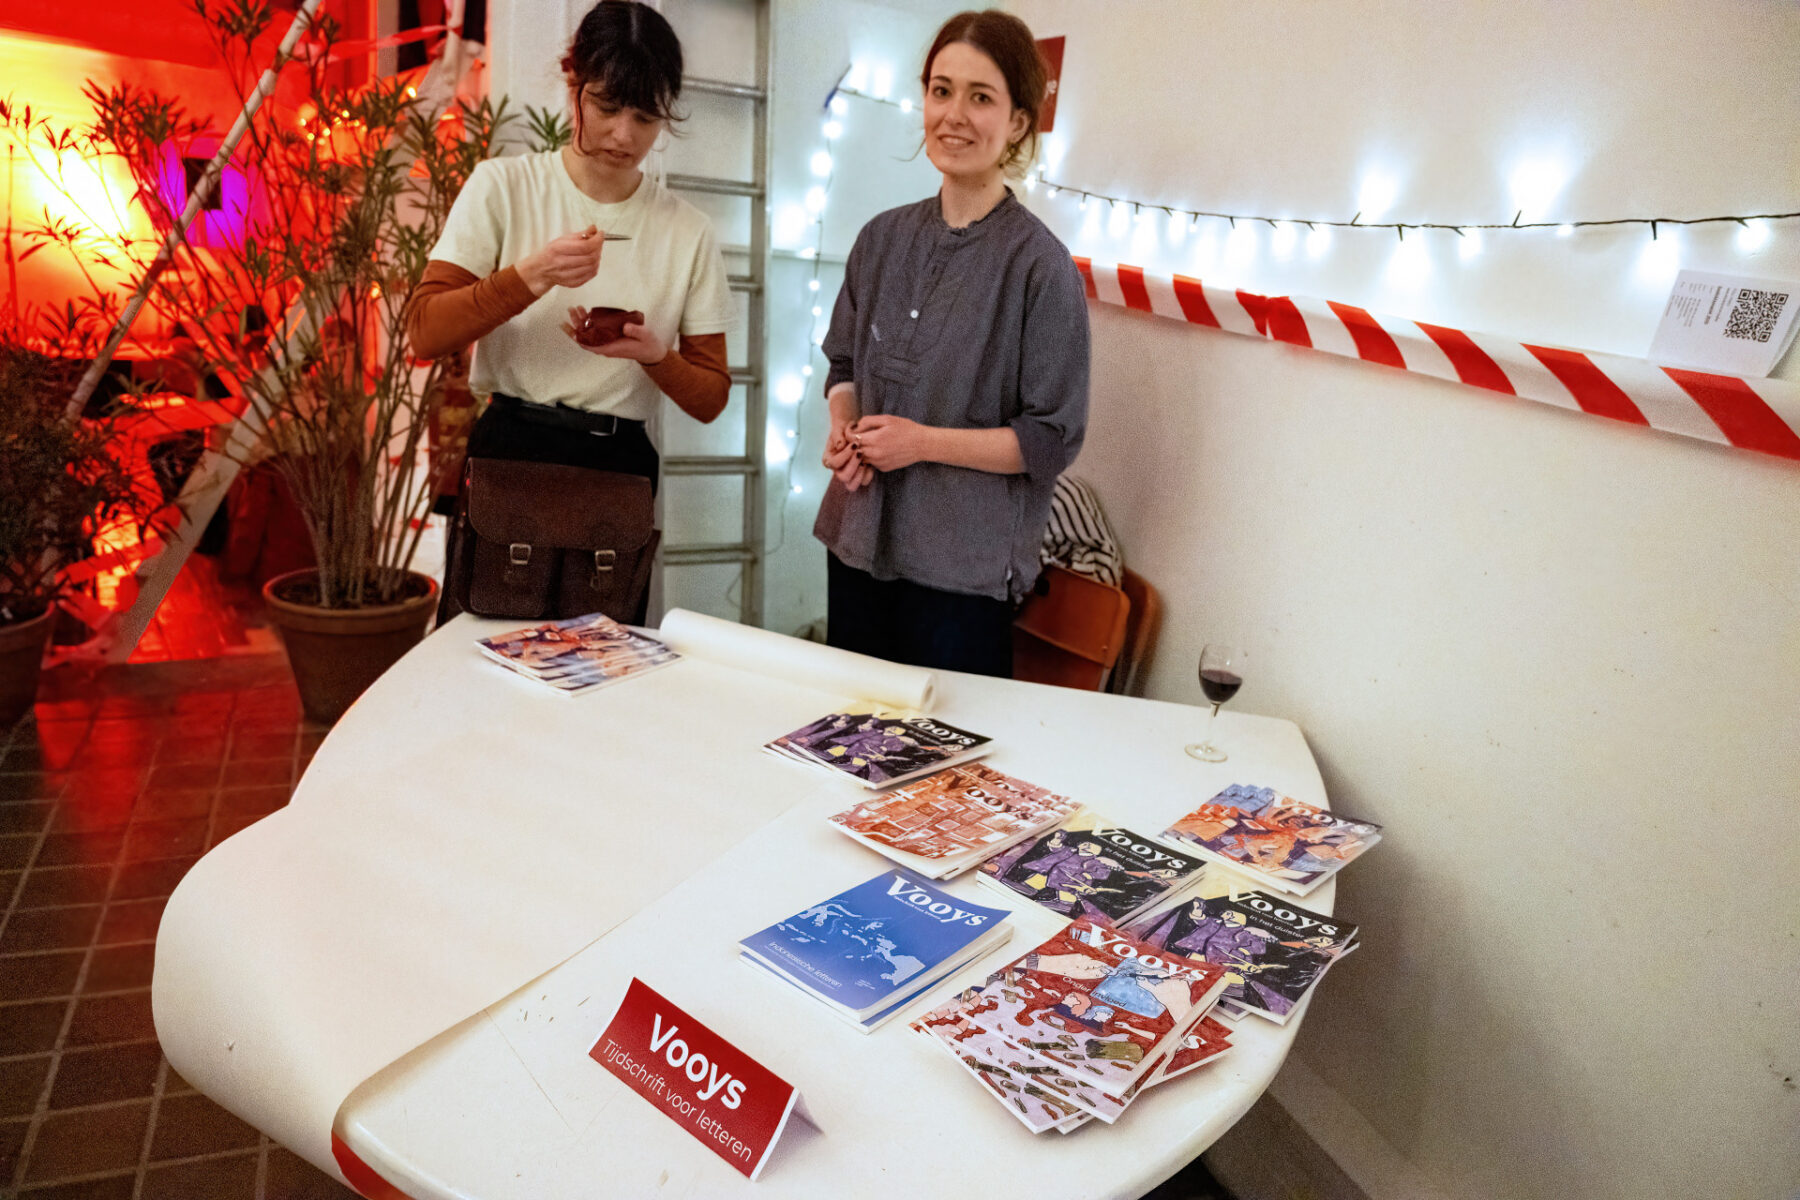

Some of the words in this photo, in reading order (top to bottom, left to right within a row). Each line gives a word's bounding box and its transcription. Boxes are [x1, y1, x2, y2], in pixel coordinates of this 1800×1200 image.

[901, 715, 976, 745] Vooys
[1091, 821, 1187, 869] Vooys
[887, 875, 988, 926] Vooys
[1228, 885, 1339, 935] Vooys
[1088, 922, 1208, 981] Vooys
[1062, 976, 1091, 993] Onder
[1092, 990, 1128, 1008] invloed
[650, 1013, 747, 1110] Vooys
[603, 1039, 667, 1096] Tijdschrift
[665, 1088, 697, 1118] voor
[696, 1110, 752, 1162] letteren
